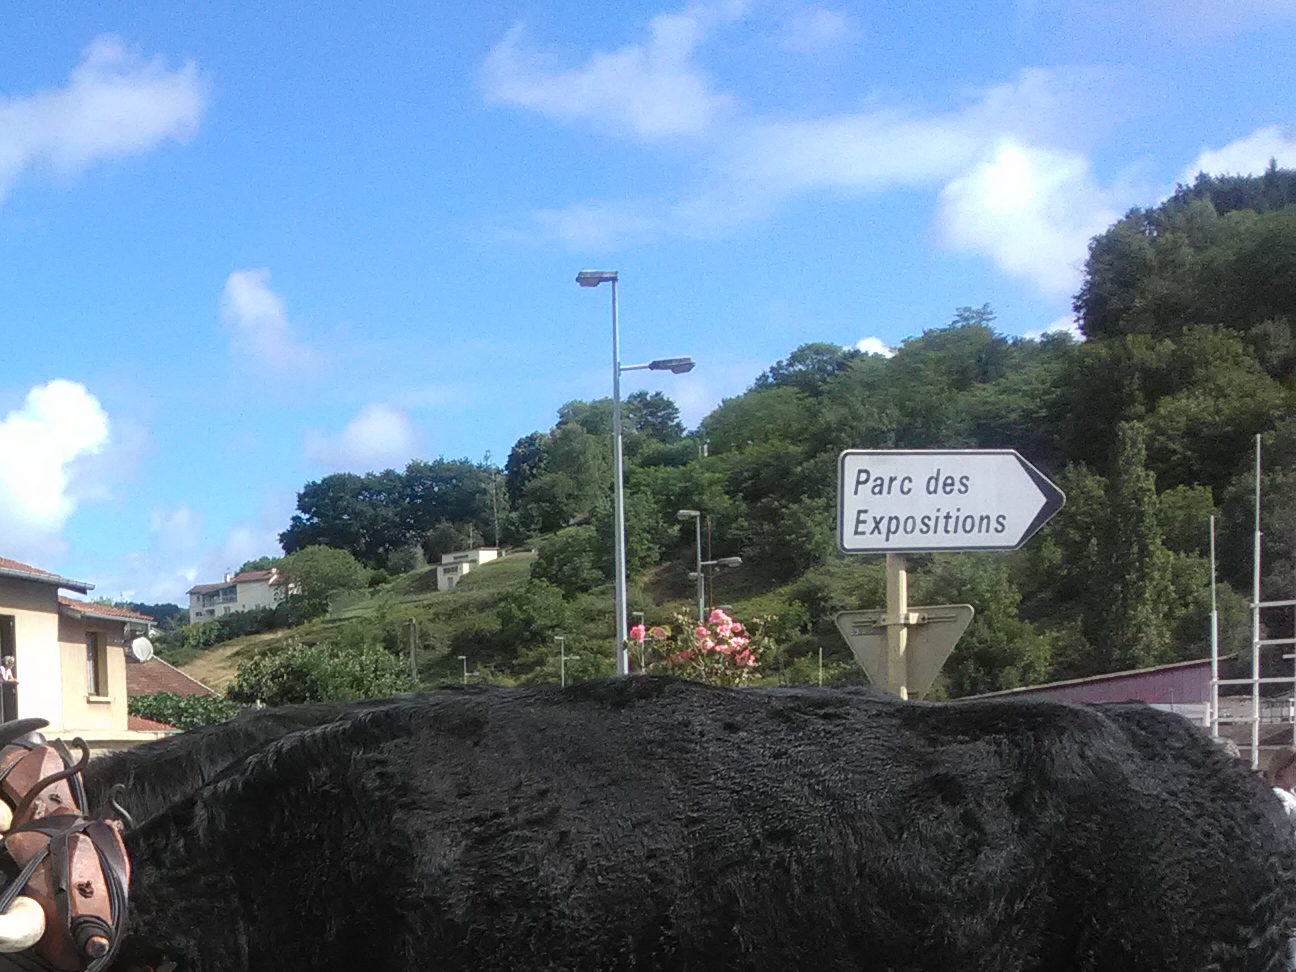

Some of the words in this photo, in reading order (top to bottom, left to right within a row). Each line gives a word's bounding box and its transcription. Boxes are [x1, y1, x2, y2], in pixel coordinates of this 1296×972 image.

[853, 468, 913, 496] Parc
[925, 468, 971, 495] des
[853, 507, 1007, 542] Expositions
